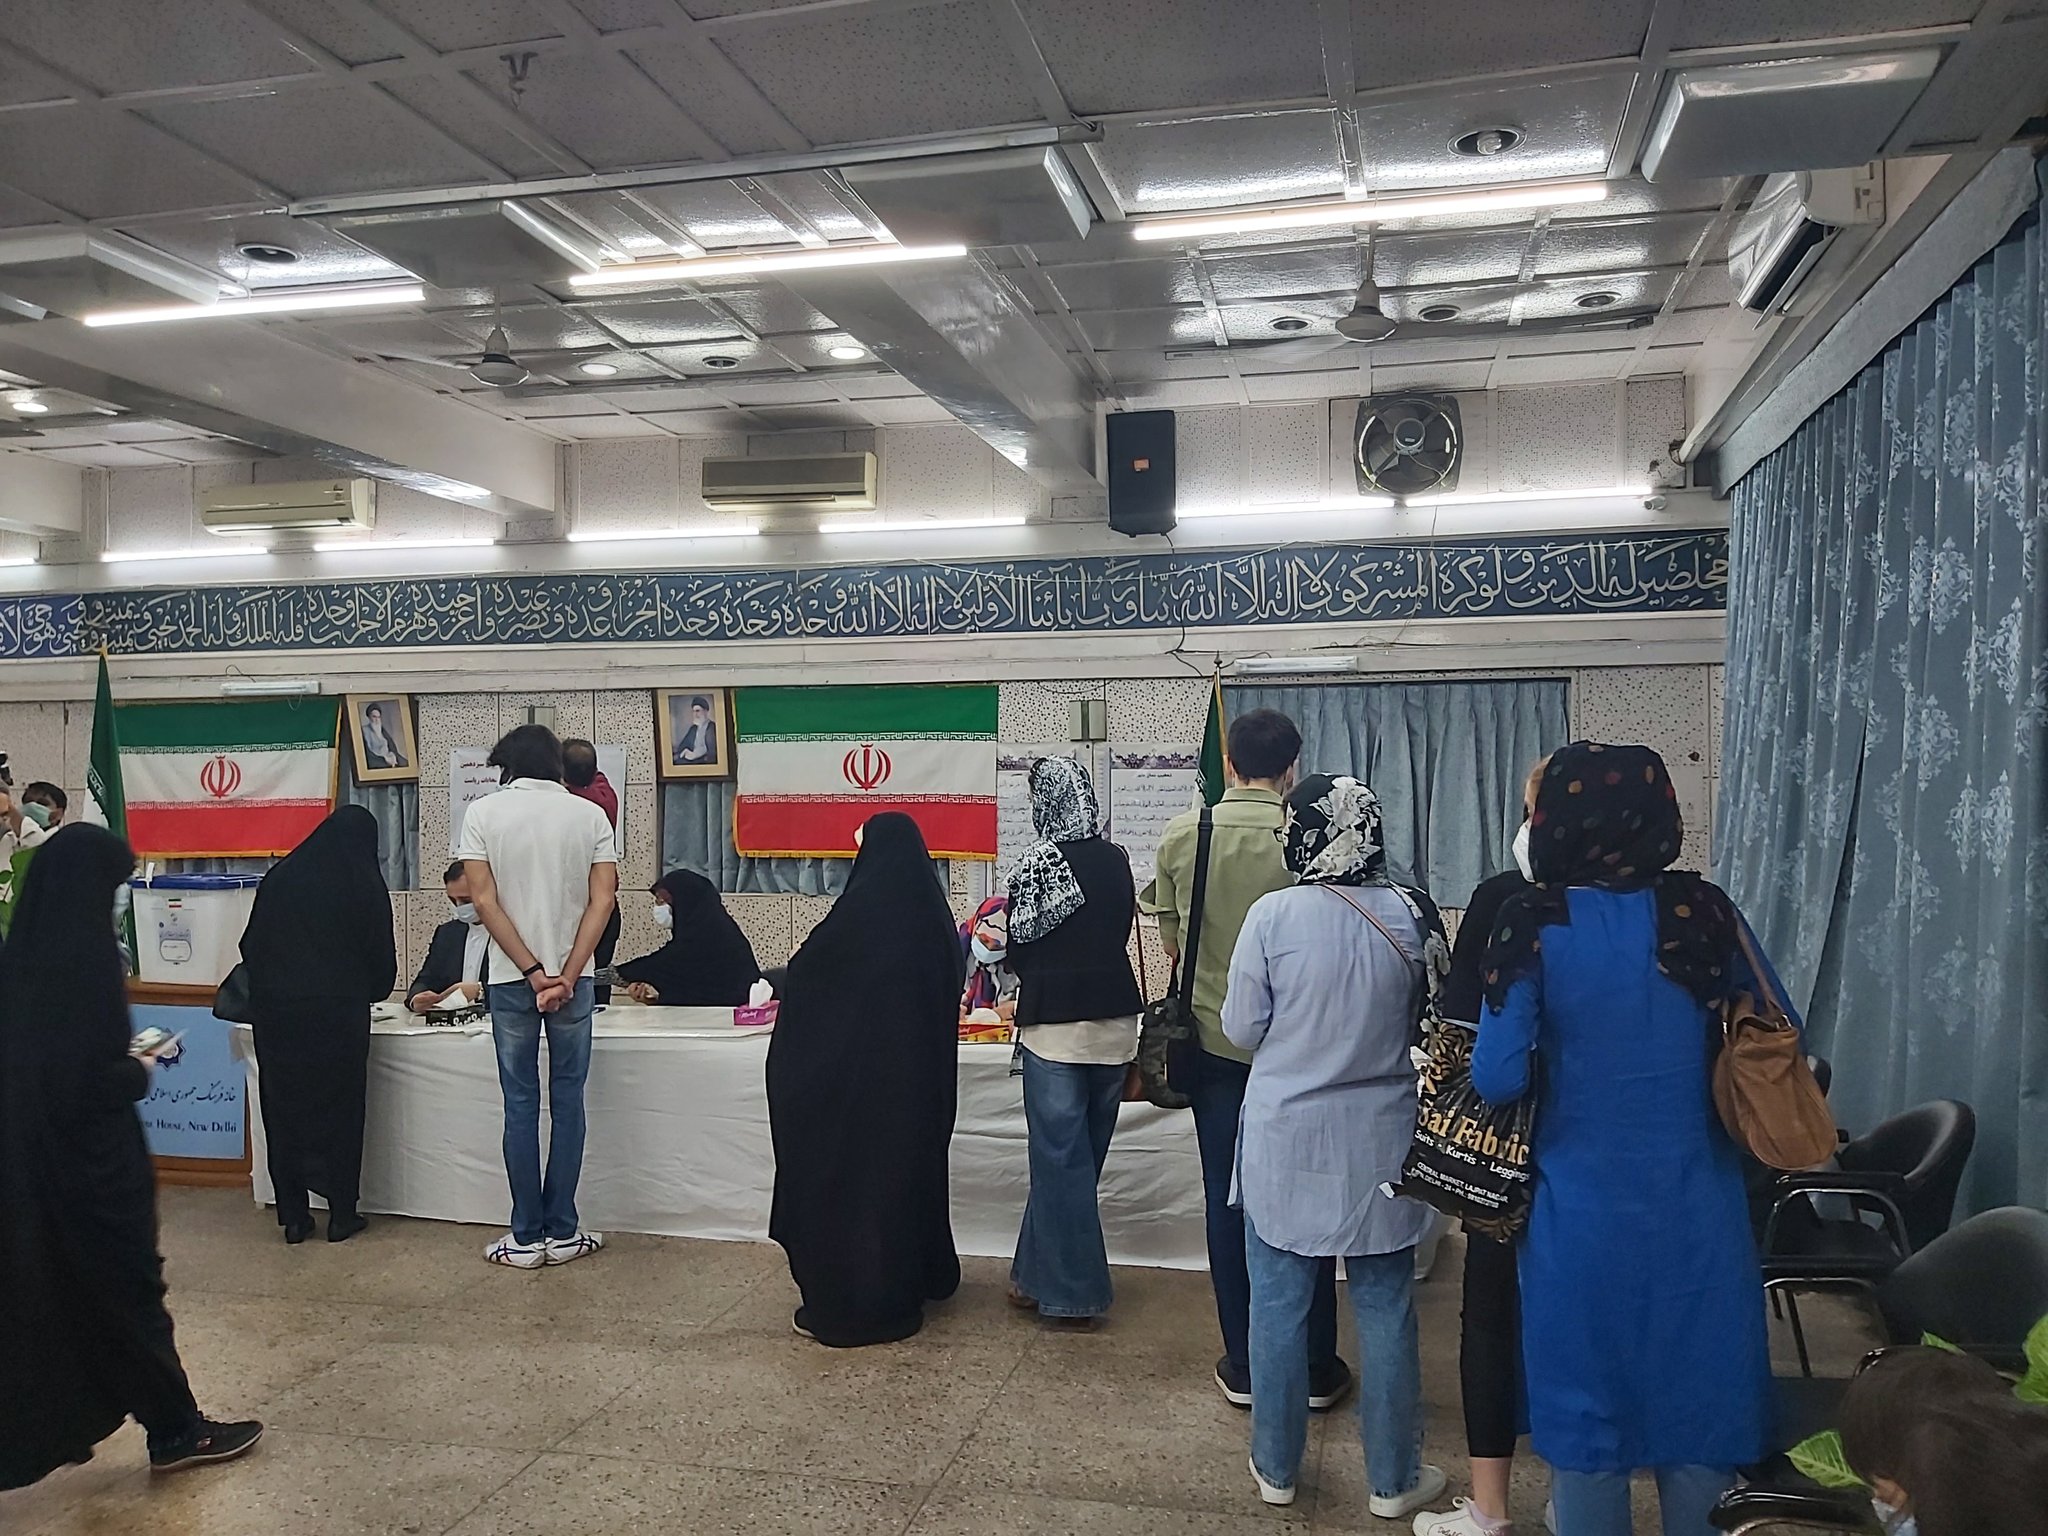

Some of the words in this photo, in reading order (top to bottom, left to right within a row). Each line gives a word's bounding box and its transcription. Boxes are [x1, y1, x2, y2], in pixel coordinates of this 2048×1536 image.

[171, 1086, 197, 1105] جمهوری
[1414, 1129, 1436, 1147] Suits
[1445, 1144, 1478, 1165] Kurtis
[1489, 1161, 1532, 1183] Leggings
[1452, 1115, 1530, 1166] Fabric
